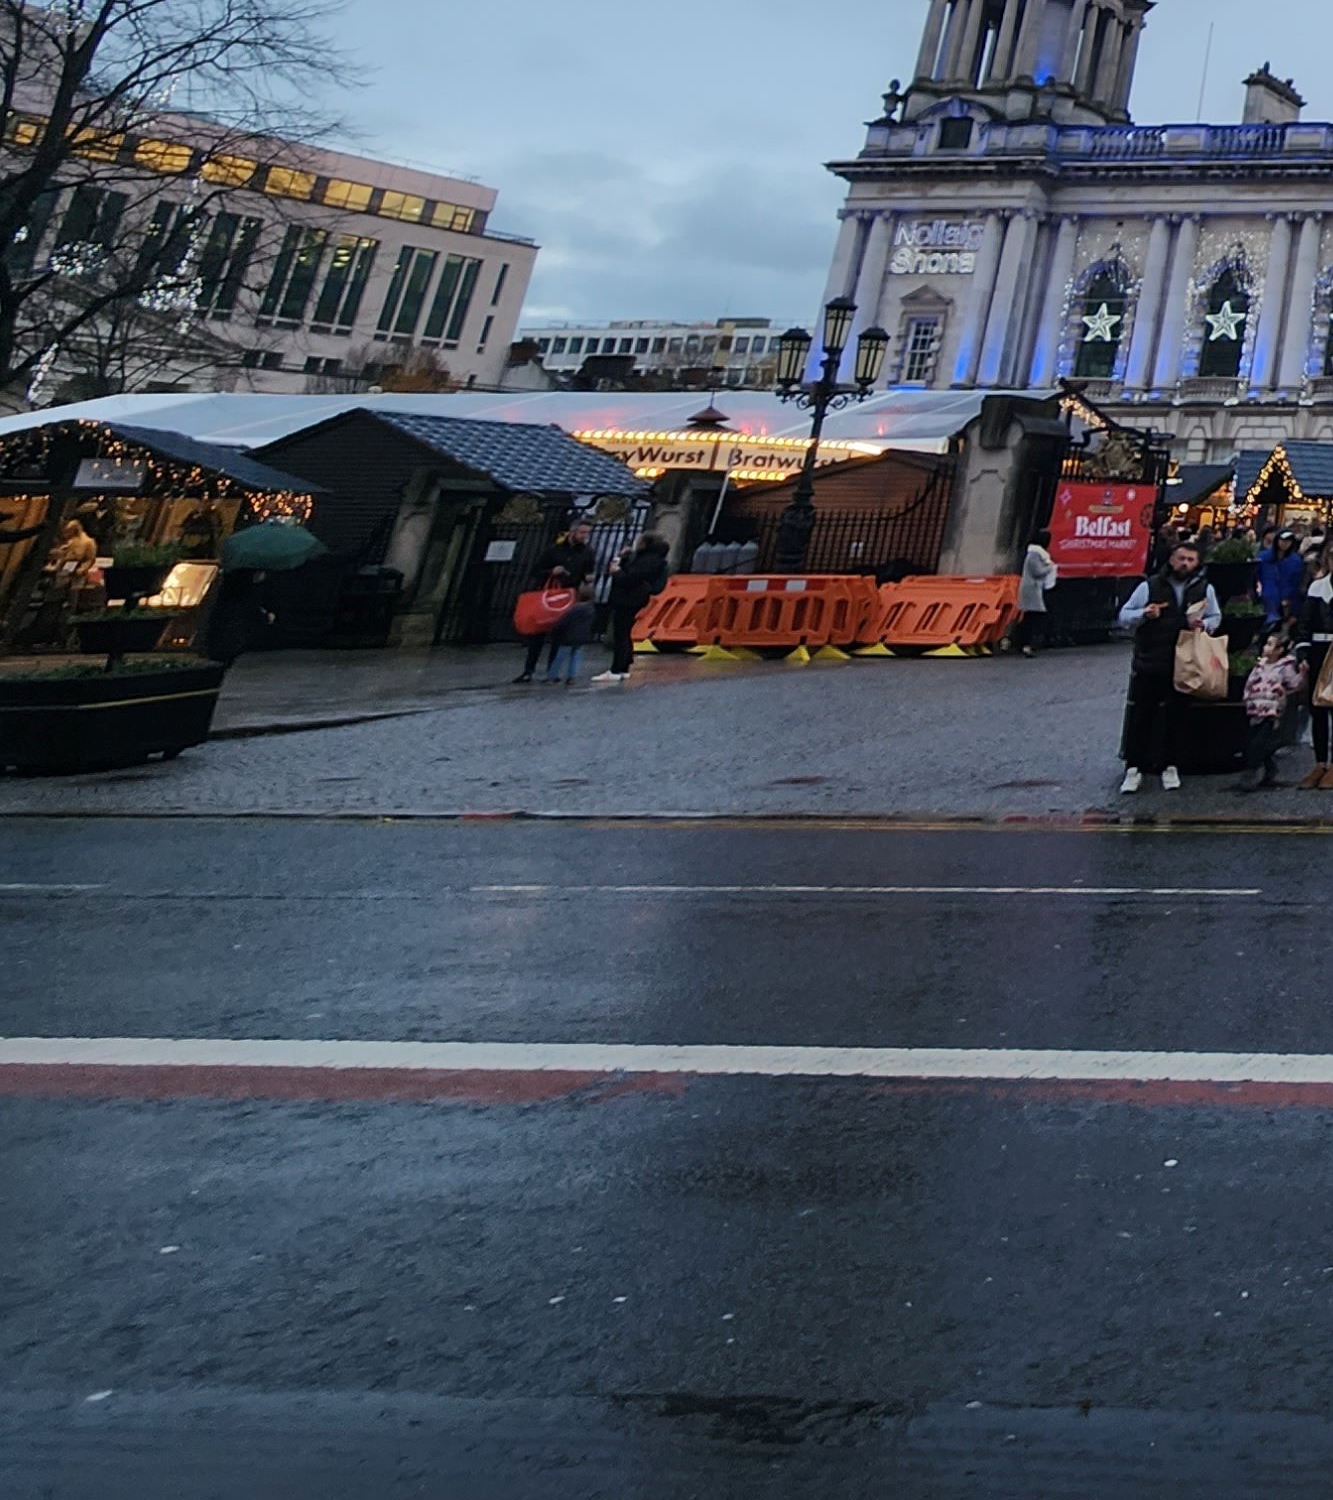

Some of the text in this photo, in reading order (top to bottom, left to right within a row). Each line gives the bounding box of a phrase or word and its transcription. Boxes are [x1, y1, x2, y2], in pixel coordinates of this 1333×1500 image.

[893, 220, 985, 249] Nollaig
[890, 247, 976, 274] Shona
[1074, 516, 1132, 537] Belfast
